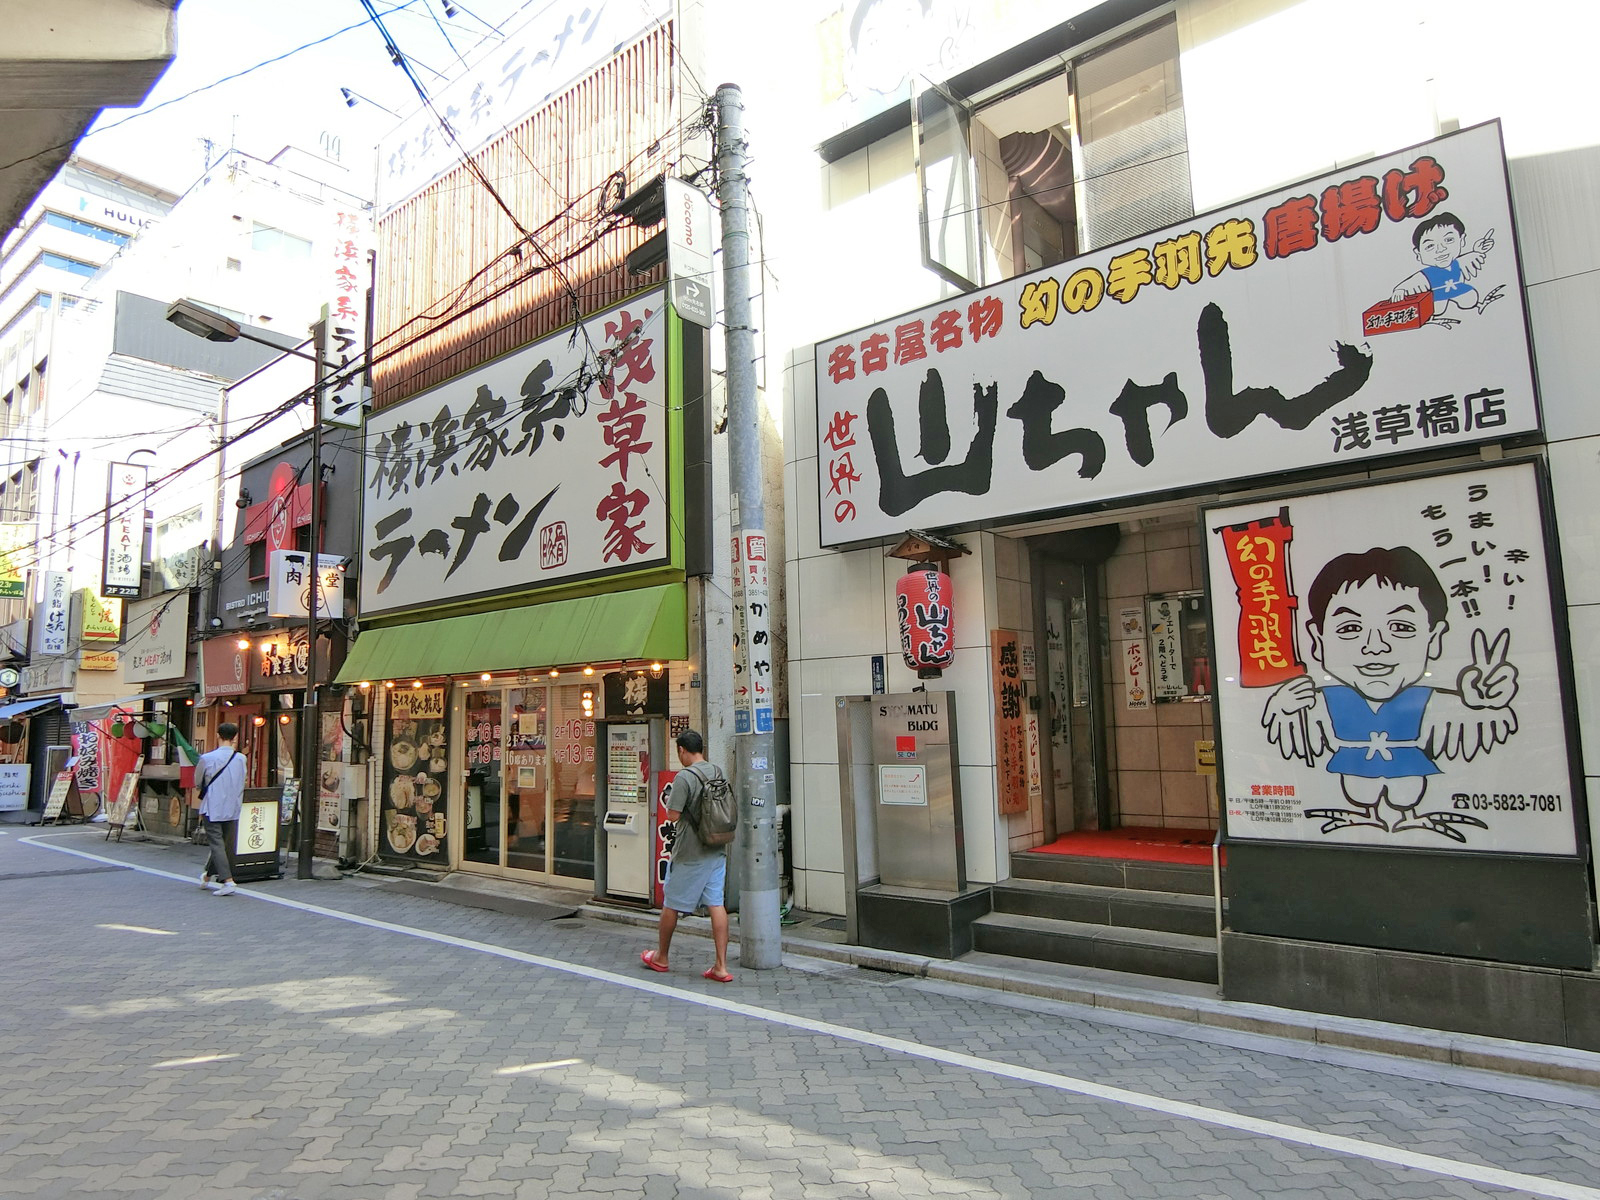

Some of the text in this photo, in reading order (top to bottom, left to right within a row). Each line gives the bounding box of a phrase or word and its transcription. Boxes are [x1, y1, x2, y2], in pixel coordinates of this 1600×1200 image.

[683, 193, 694, 247] docomo
[1262, 155, 1450, 260] 唐揚げ
[1018, 217, 1258, 330] 幻の手羽先
[827, 295, 1005, 385] 名古屋名物
[1366, 306, 1418, 329] 幻の手羽先
[368, 358, 573, 500] 横浜家系
[596, 308, 657, 564] 浅草家
[866, 301, 1374, 518] 山ちゃん
[1330, 387, 1508, 454] 浅草橋店
[823, 410, 863, 524] 世界の
[368, 482, 562, 595] ラーメン
[106, 587, 118, 595] 2F
[225, 598, 245, 611] BISTRO
[285, 567, 341, 589] 肉堂
[924, 572, 941, 602] 世界の
[1236, 535, 1288, 671] 幻の手羽先
[749, 602, 770, 676] かめや
[914, 603, 952, 664] 山ちゃん
[1158, 639, 1169, 682] 2階へどうぞ
[1166, 620, 1177, 670] エレベーターで
[261, 655, 293, 677] 肉食堂
[999, 641, 1022, 720] 感謝
[1127, 642, 1144, 687] ホッピー
[879, 703, 938, 717] SMATU
[907, 720, 938, 731] BLDG
[78, 732, 98, 791] お好み焼き
[1027, 719, 1039, 770] ホッピー
[1250, 784, 1295, 797] 営業時間
[1471, 793, 1563, 813] 03-5823-7081
